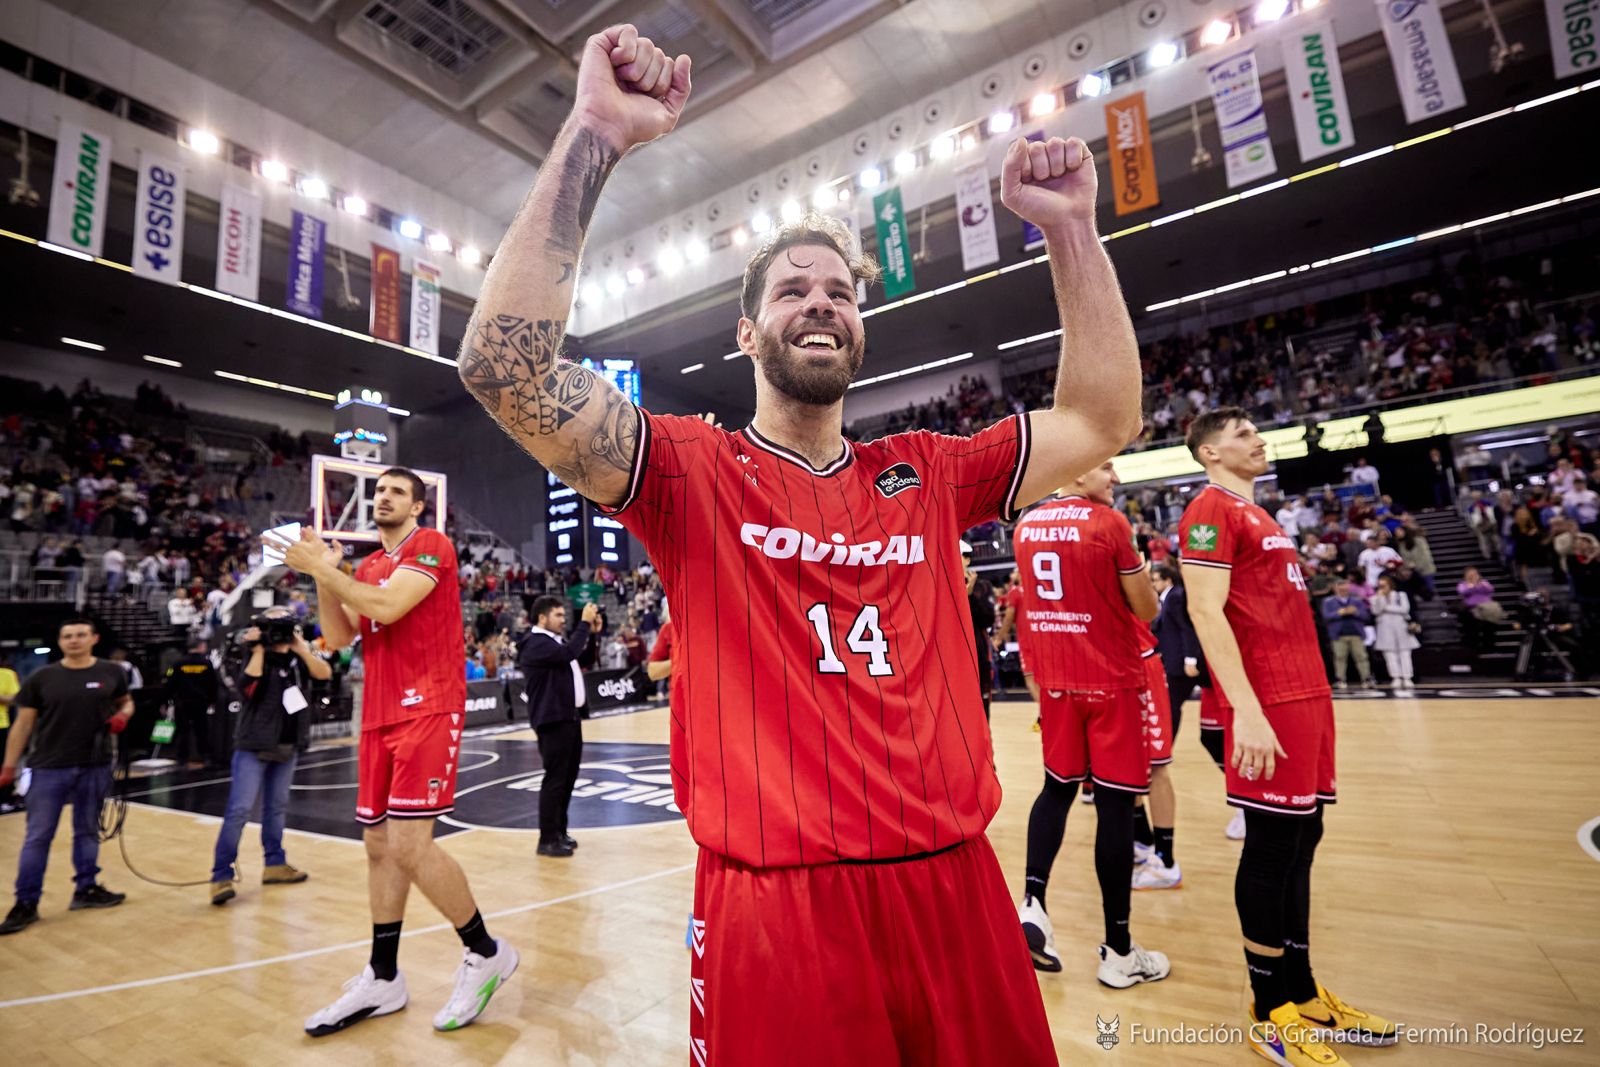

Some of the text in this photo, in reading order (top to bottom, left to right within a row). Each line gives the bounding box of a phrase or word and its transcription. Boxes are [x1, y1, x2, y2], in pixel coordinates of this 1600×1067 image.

[1403, 19, 1444, 112] emasagra
[145, 165, 175, 249] asisa
[225, 208, 241, 274] RICOH
[880, 475, 898, 487] liga
[886, 477, 919, 491] endesa
[1020, 526, 1080, 543] PULEVA
[1032, 551, 1064, 600] 9
[806, 602, 895, 677] 14
[598, 678, 636, 701] alight
